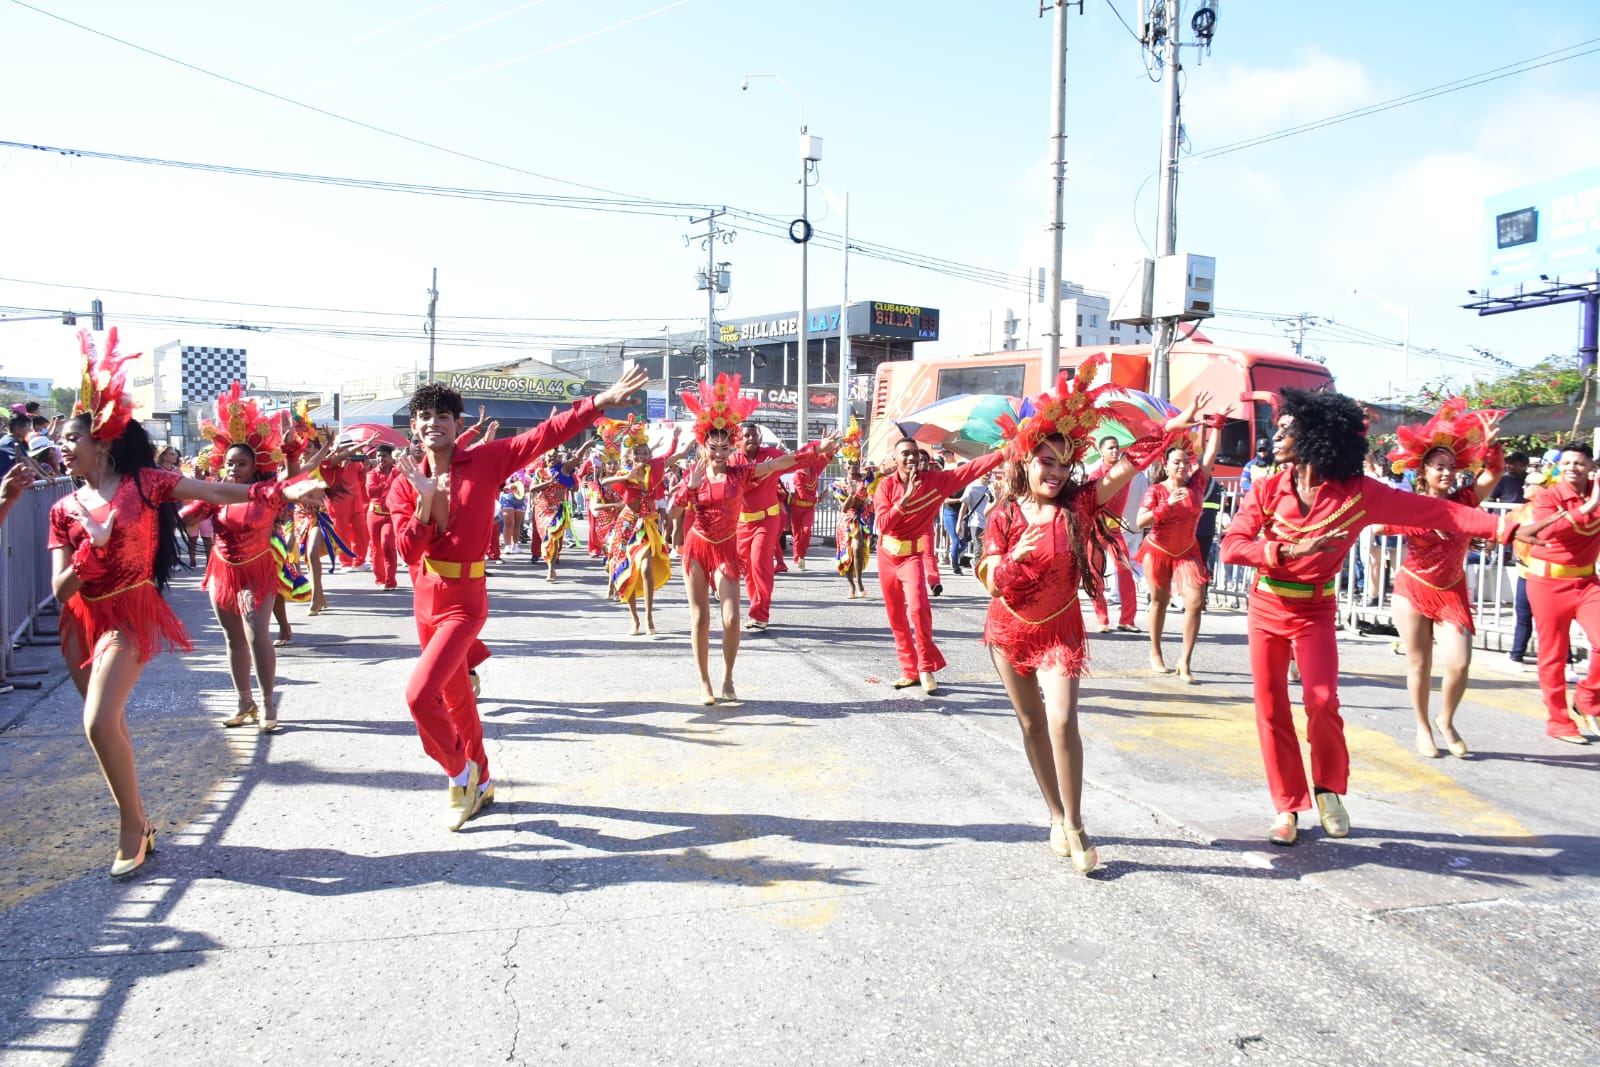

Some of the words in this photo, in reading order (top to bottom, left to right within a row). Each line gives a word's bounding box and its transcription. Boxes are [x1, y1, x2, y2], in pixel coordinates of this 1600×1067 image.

[808, 314, 828, 332] LA
[451, 376, 526, 393] MAXILUJOS
[528, 381, 545, 393] LA
[547, 381, 564, 395] 44
